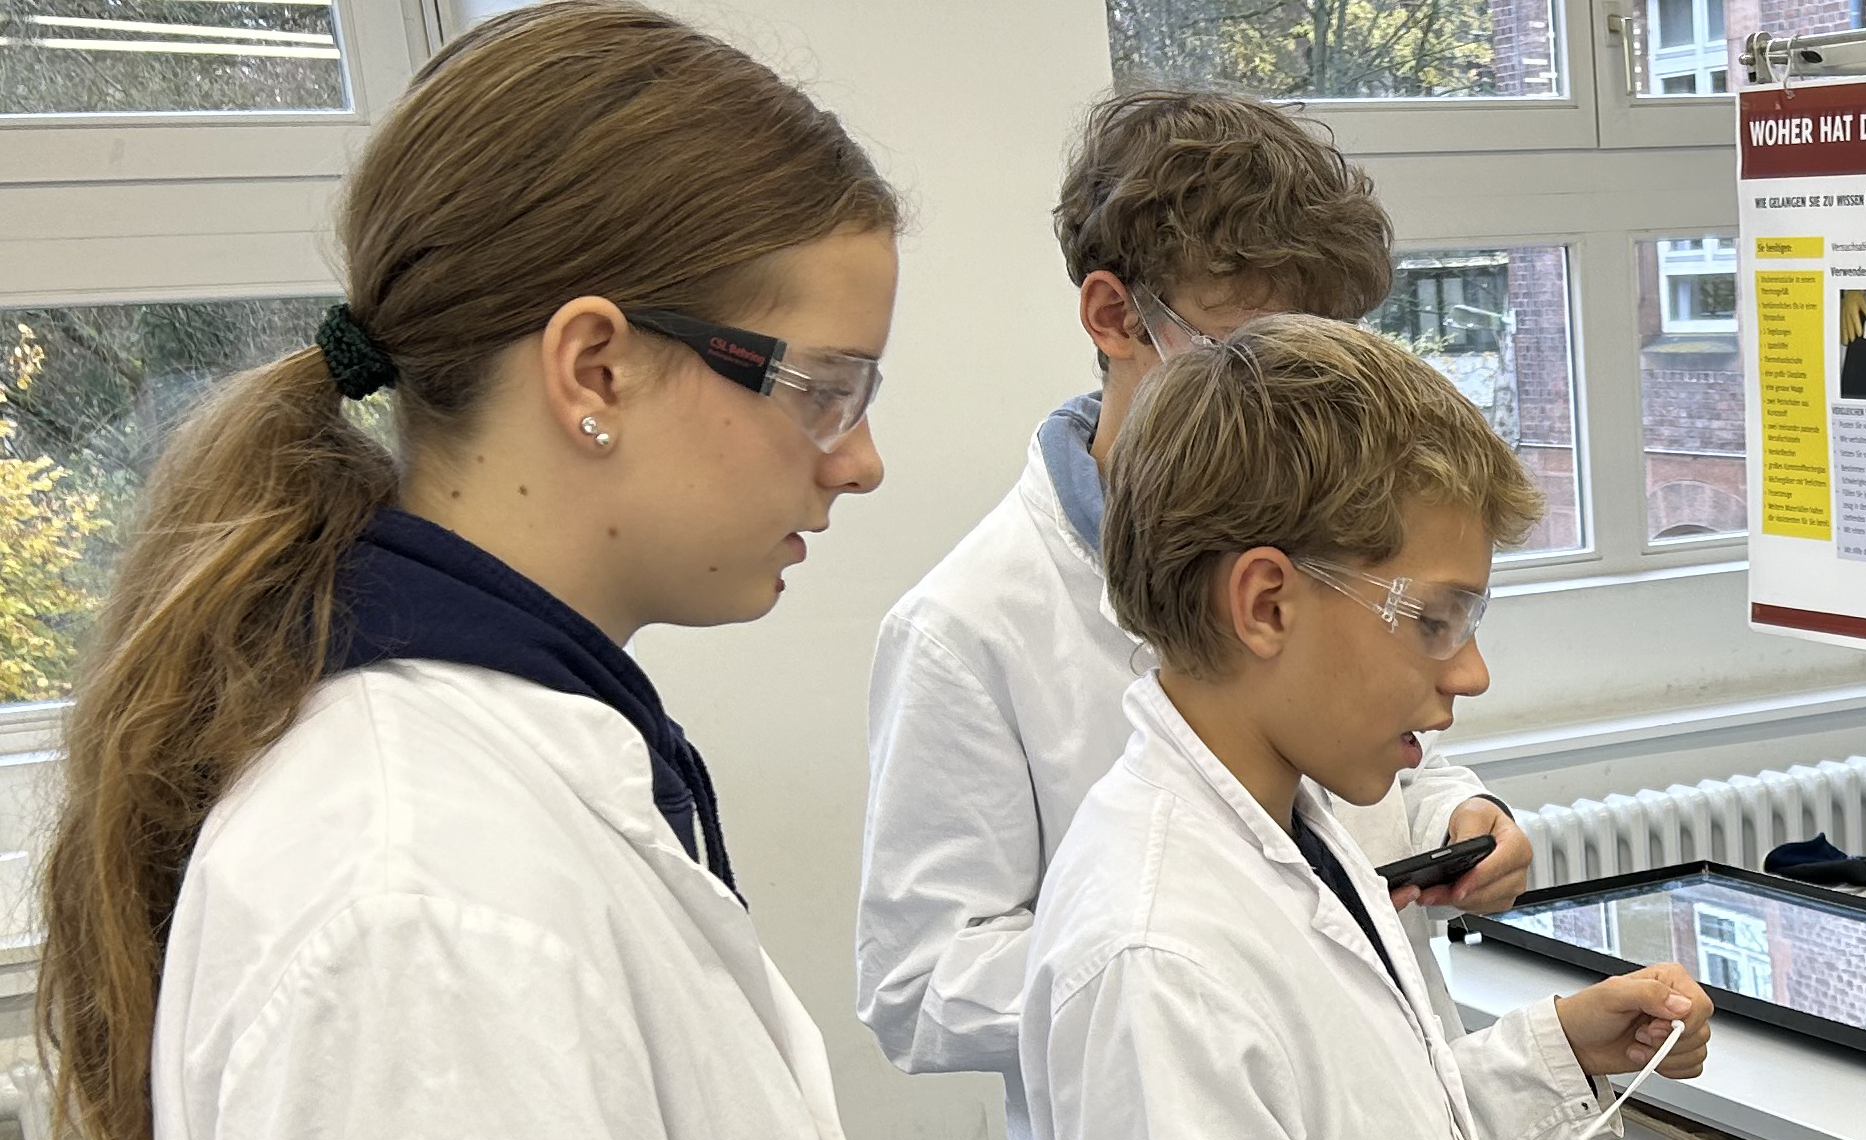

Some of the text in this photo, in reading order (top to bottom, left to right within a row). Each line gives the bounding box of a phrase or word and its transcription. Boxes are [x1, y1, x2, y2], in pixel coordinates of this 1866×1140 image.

[1749, 118, 1813, 145] WOHER
[1819, 114, 1852, 142] HAT
[1754, 197, 1767, 208] WIE
[1768, 196, 1806, 208] GELANGEN
[1808, 195, 1820, 207] SIE
[1822, 195, 1834, 207] ZU
[1836, 194, 1864, 206] WISSEN
